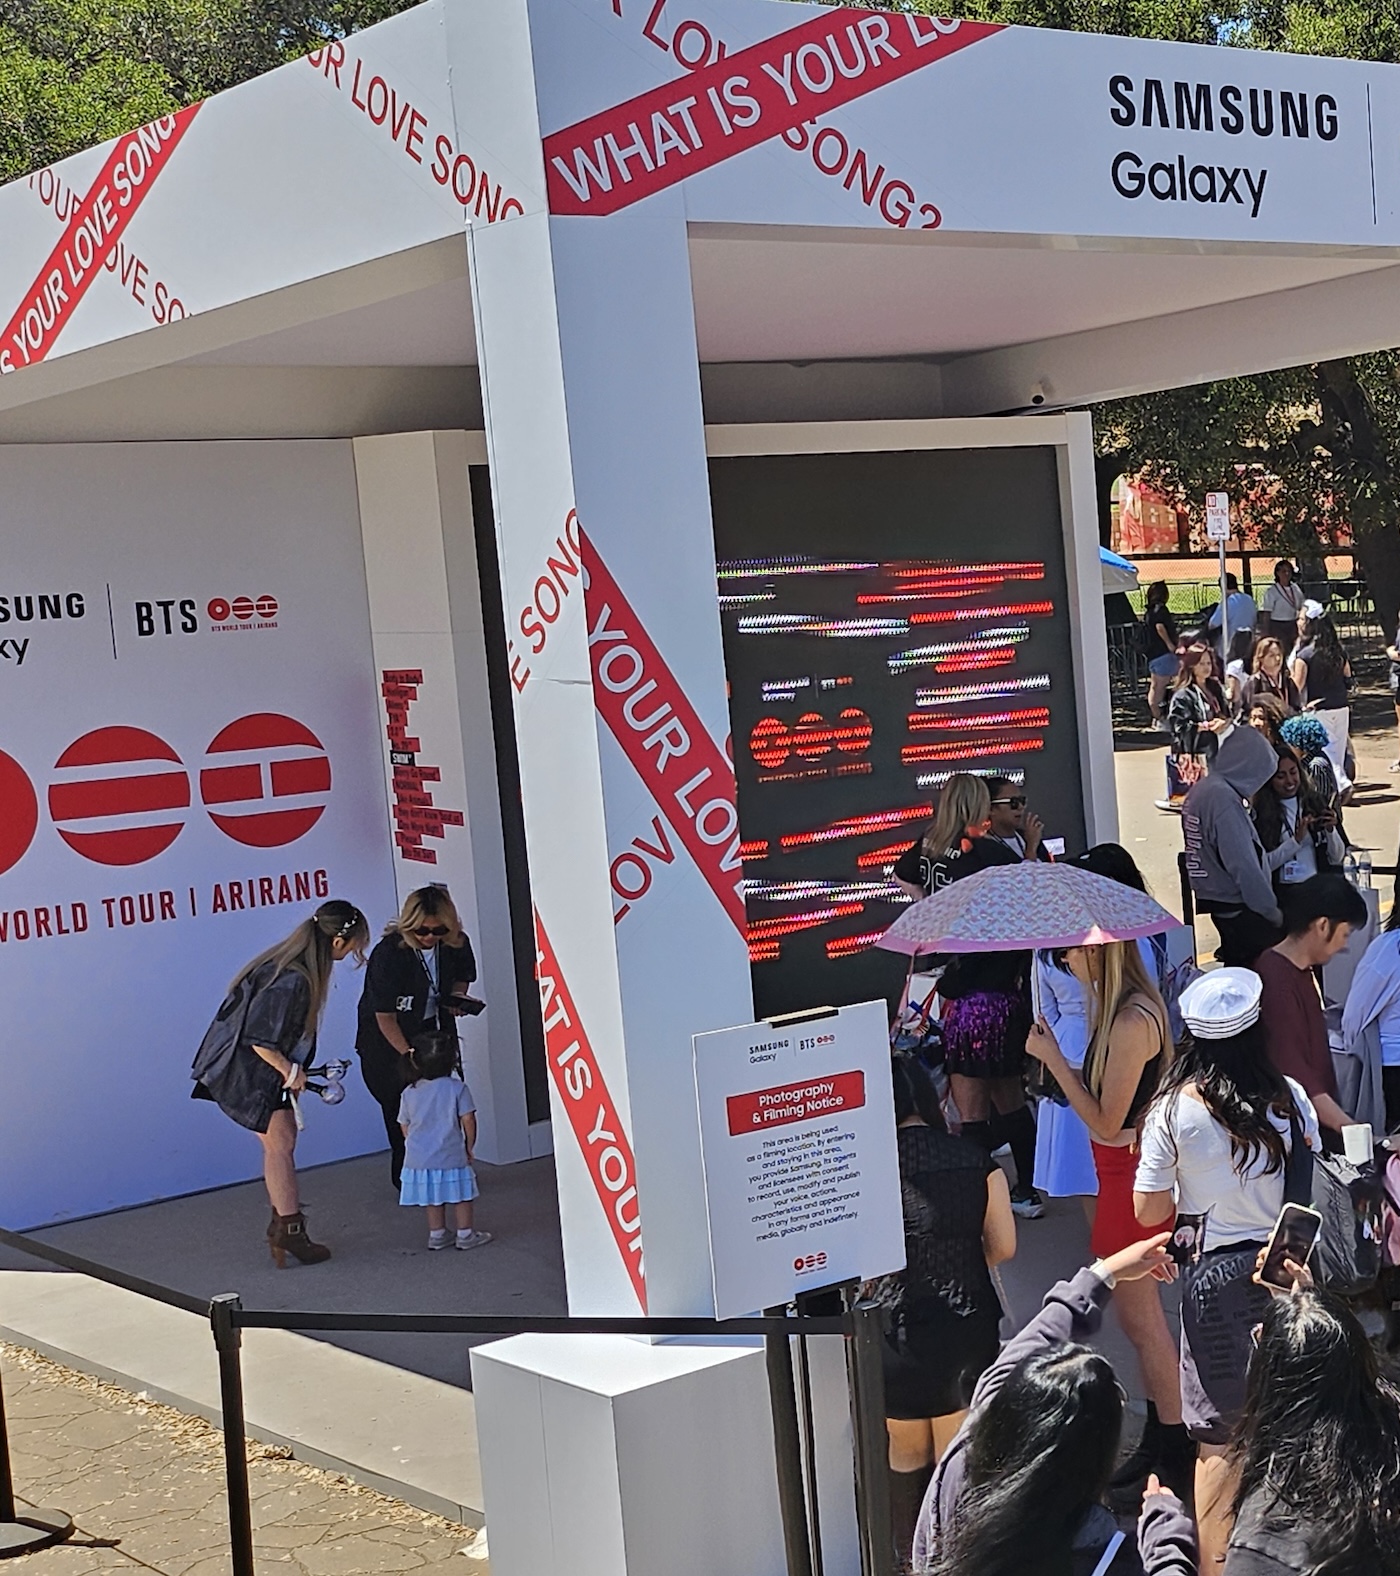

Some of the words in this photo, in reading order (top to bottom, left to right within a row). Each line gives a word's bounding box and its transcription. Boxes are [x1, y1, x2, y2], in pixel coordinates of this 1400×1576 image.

[351, 58, 428, 165] LOVE
[551, 95, 704, 203] WHAT
[706, 75, 762, 137] IS
[761, 14, 901, 107] YOUR
[1109, 75, 1338, 141] SAMSUNG
[1112, 151, 1267, 218] Galaxy
[12, 268, 70, 364] YOUR
[63, 185, 119, 288] LOVE
[135, 598, 198, 637] BTS
[588, 603, 691, 774] YOUR
[102, 889, 176, 929] TOUR
[212, 869, 329, 914] ARIRANG
[749, 1040, 790, 1055] SAMSUNG
[749, 1053, 777, 1064] Galaxy
[799, 1038, 816, 1051] BTS
[556, 1040, 593, 1101] IS
[752, 1112, 762, 1124] &
[763, 1104, 805, 1122] Filming
[806, 1095, 844, 1112] Notice
[758, 1082, 834, 1107] Photography
[746, 1155, 756, 1163] as
[762, 1148, 786, 1158] filming
[817, 1139, 826, 1148] By
[826, 1132, 856, 1144] entering
[762, 1139, 776, 1149] This
[777, 1137, 794, 1146] area
[801, 1129, 821, 1140] being
[821, 1125, 839, 1135] used
[748, 1174, 762, 1185] you
[762, 1168, 789, 1182] provide
[832, 1152, 857, 1163] agents
[761, 1160, 776, 1169] and
[777, 1155, 803, 1166] staying
[803, 1152, 810, 1160] in
[810, 1149, 823, 1158] this
[747, 1196, 756, 1204] to
[797, 1179, 821, 1192] modify
[822, 1175, 836, 1185] and
[836, 1170, 861, 1184] publish
[757, 1181, 772, 1190] and
[772, 1174, 805, 1187] licensees
[805, 1170, 821, 1180] with
[821, 1163, 850, 1175] consent
[751, 1205, 803, 1223] characteristics
[803, 1201, 818, 1210] and
[818, 1190, 860, 1207] appearance
[767, 1221, 775, 1229] in
[775, 1217, 789, 1227] any
[789, 1213, 810, 1223] forms
[811, 1209, 825, 1219] and
[826, 1207, 833, 1215] in
[833, 1204, 847, 1213] any
[773, 1198, 789, 1209] your
[780, 1223, 808, 1238] globally
[809, 1219, 823, 1229] and
